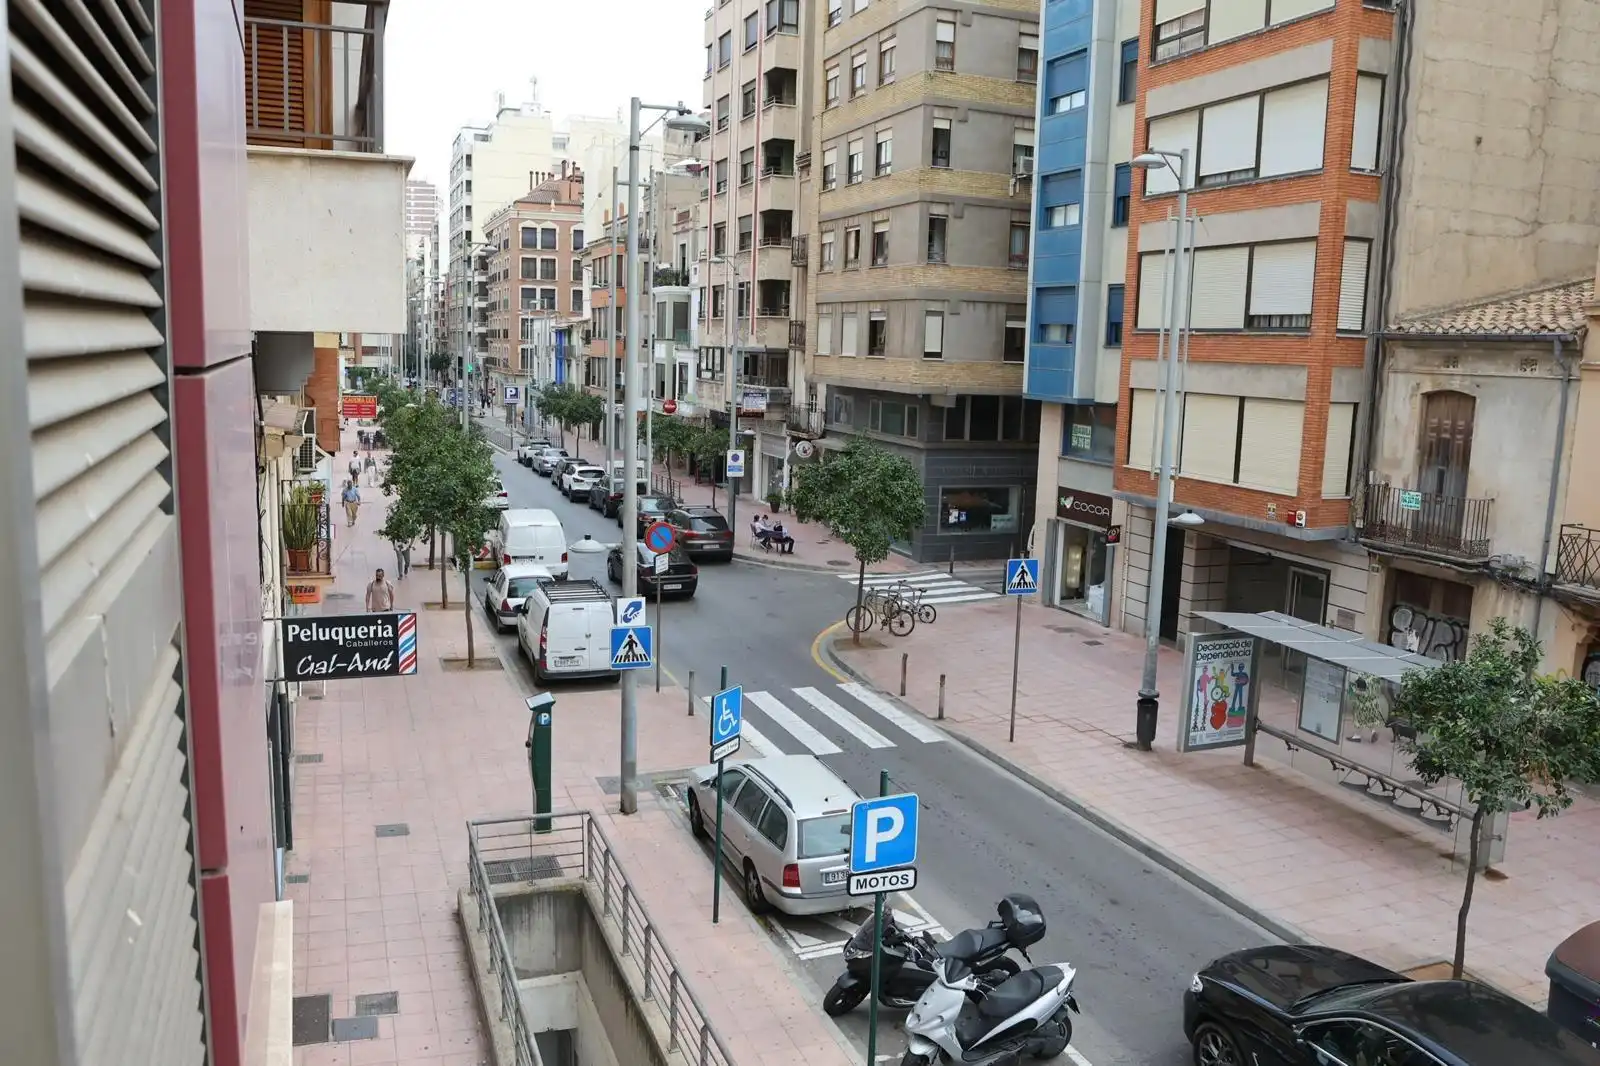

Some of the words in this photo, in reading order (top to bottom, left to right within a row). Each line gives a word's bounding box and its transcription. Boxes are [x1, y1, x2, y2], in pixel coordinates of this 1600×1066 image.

[506, 387, 516, 399] P
[1073, 501, 1110, 517] COCOA
[287, 619, 394, 646] Peluqueria
[345, 639, 394, 648] Caballeros
[1240, 639, 1252, 648] de
[297, 650, 394, 676] Gal-And
[541, 712, 550, 725] P
[864, 806, 905, 863] P
[855, 873, 910, 890] MOTOS
